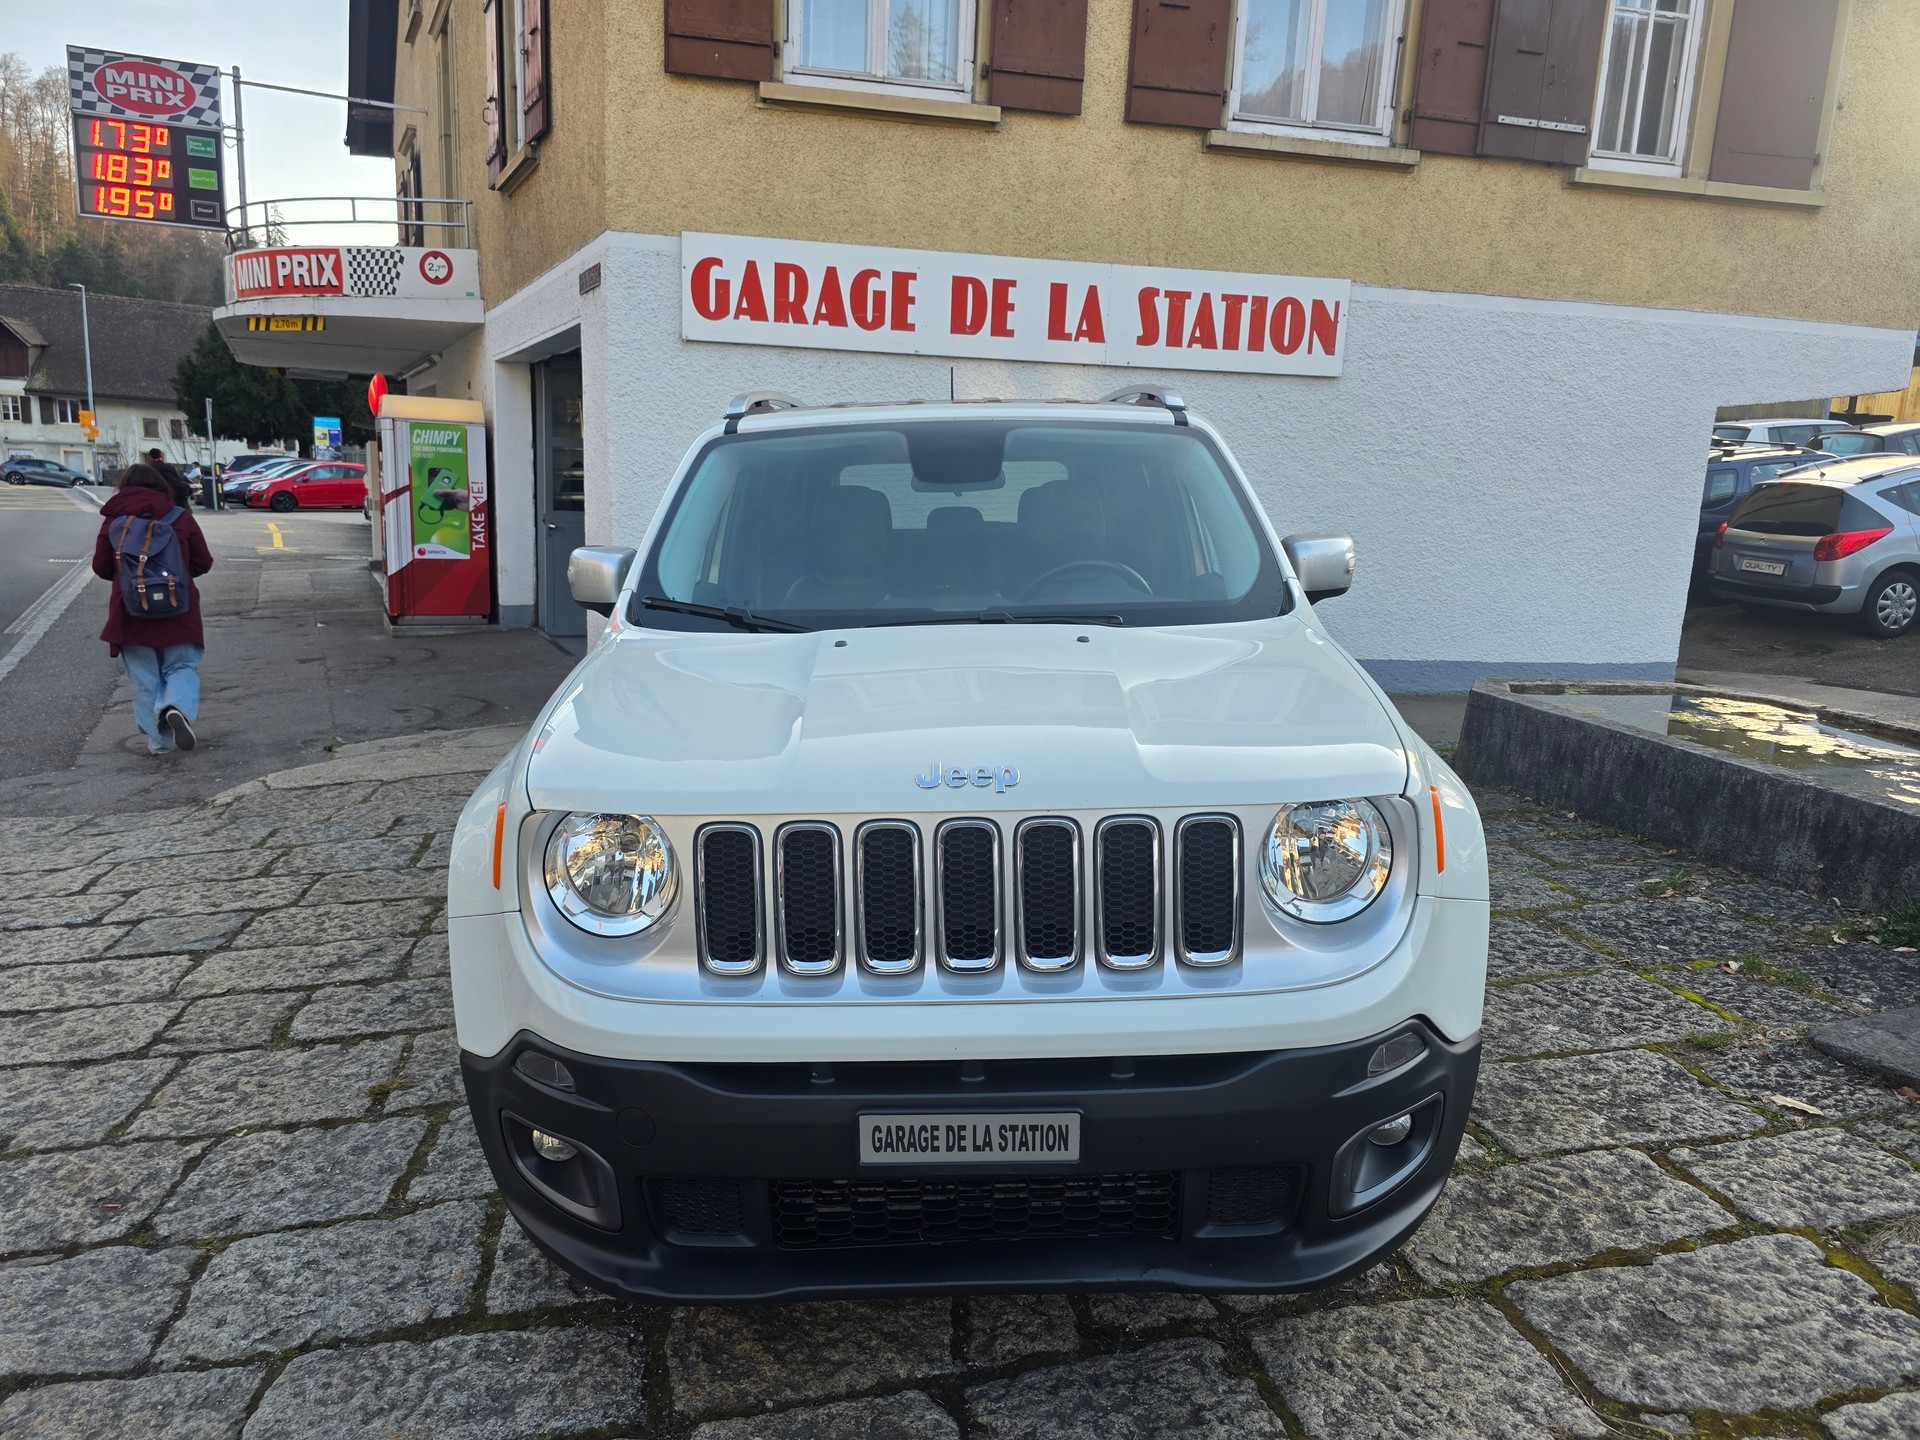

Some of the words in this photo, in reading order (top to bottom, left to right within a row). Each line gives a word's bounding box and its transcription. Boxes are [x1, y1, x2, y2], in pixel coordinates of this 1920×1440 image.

[105, 68, 185, 92] MINI
[106, 85, 187, 108] PRIX
[237, 256, 271, 290] MINI
[276, 254, 339, 288] PRIX
[690, 256, 917, 333] GARAGE
[950, 274, 1017, 338] DE
[1047, 282, 1106, 343] LA
[1136, 286, 1340, 356] STATION
[413, 429, 461, 446] CHIMPY
[471, 512, 486, 551] TAKE
[1744, 562, 1777, 572] QUALITY
[914, 760, 1020, 793] Jeep
[871, 1124, 940, 1153] GARAGE
[945, 1124, 967, 1153] DE
[972, 1124, 993, 1152] LA
[998, 1123, 1069, 1152] STATION
